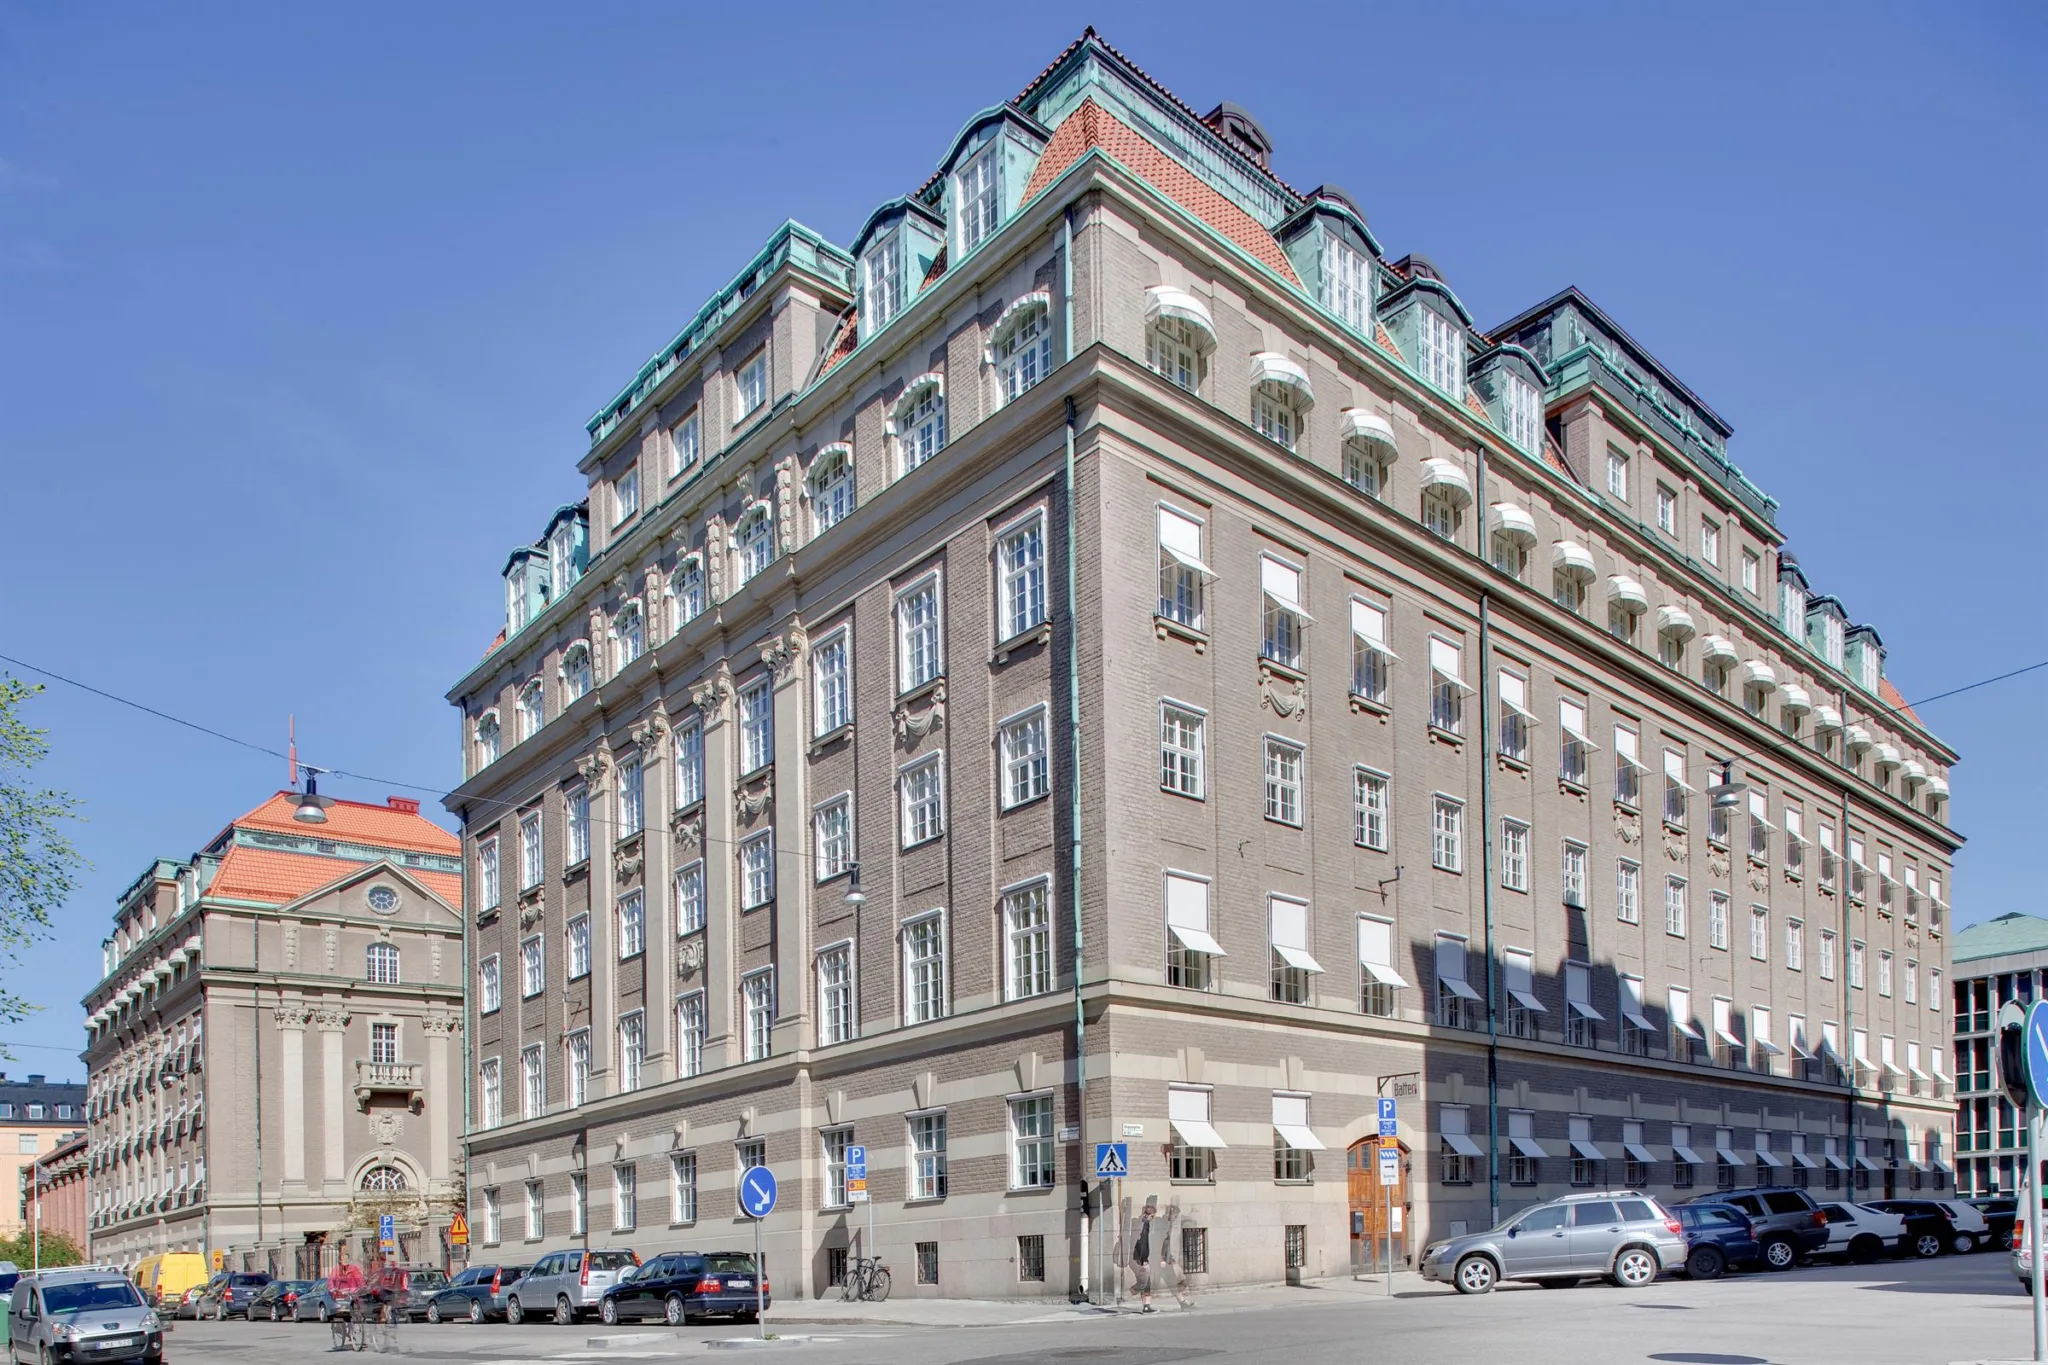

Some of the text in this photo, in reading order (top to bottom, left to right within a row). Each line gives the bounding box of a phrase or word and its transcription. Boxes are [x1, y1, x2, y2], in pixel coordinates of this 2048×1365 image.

[1383, 1101, 1392, 1118] P
[852, 1148, 861, 1164] P
[383, 1216, 390, 1226] P
